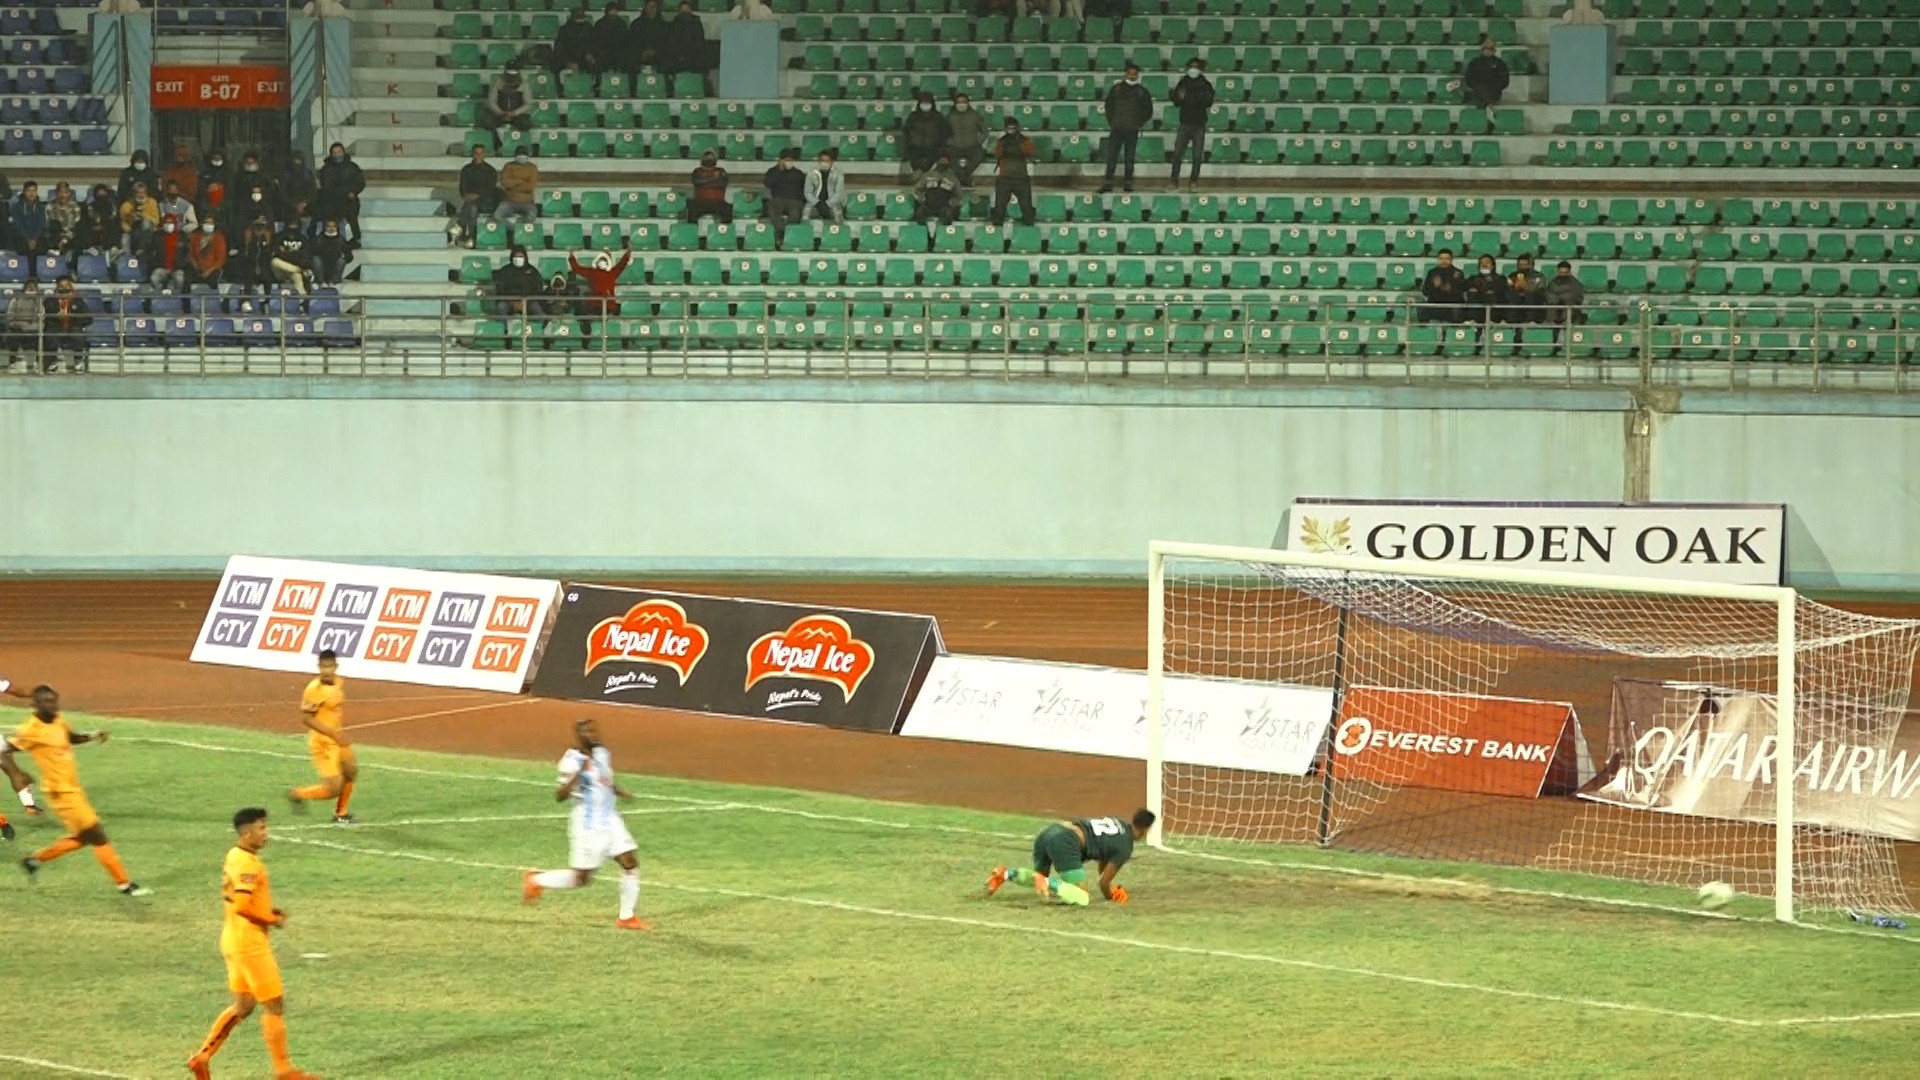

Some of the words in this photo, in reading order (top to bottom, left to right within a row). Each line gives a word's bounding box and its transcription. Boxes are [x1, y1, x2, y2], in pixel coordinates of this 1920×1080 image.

[156, 81, 184, 92] EXIT
[200, 83, 240, 100] B-07
[257, 81, 284, 92] EXIT
[387, 83, 398, 95] K
[391, 112, 401, 124] L
[1366, 523, 1617, 563] GOLDEN
[1635, 526, 1766, 565] OAK
[226, 580, 267, 606] KTM
[278, 584, 320, 610] KTM
[331, 589, 373, 614] KTM
[384, 593, 426, 620] KTM
[438, 597, 480, 624] KTM
[492, 601, 534, 628] KTM
[213, 618, 252, 644] CTY
[266, 622, 305, 648] CTY
[319, 627, 358, 653] CTY
[602, 623, 659, 660] Nepal
[659, 628, 690, 656] Ice
[372, 632, 411, 658] CTY
[425, 637, 464, 663] CTY
[480, 641, 519, 668] CTY
[763, 638, 823, 675] Nepal
[823, 645, 855, 673] Ice
[1057, 697, 1105, 719] STAR
[1370, 730, 1479, 757] EVEREST
[1481, 740, 1551, 763] BANK
[1634, 726, 1777, 786] QATAR
